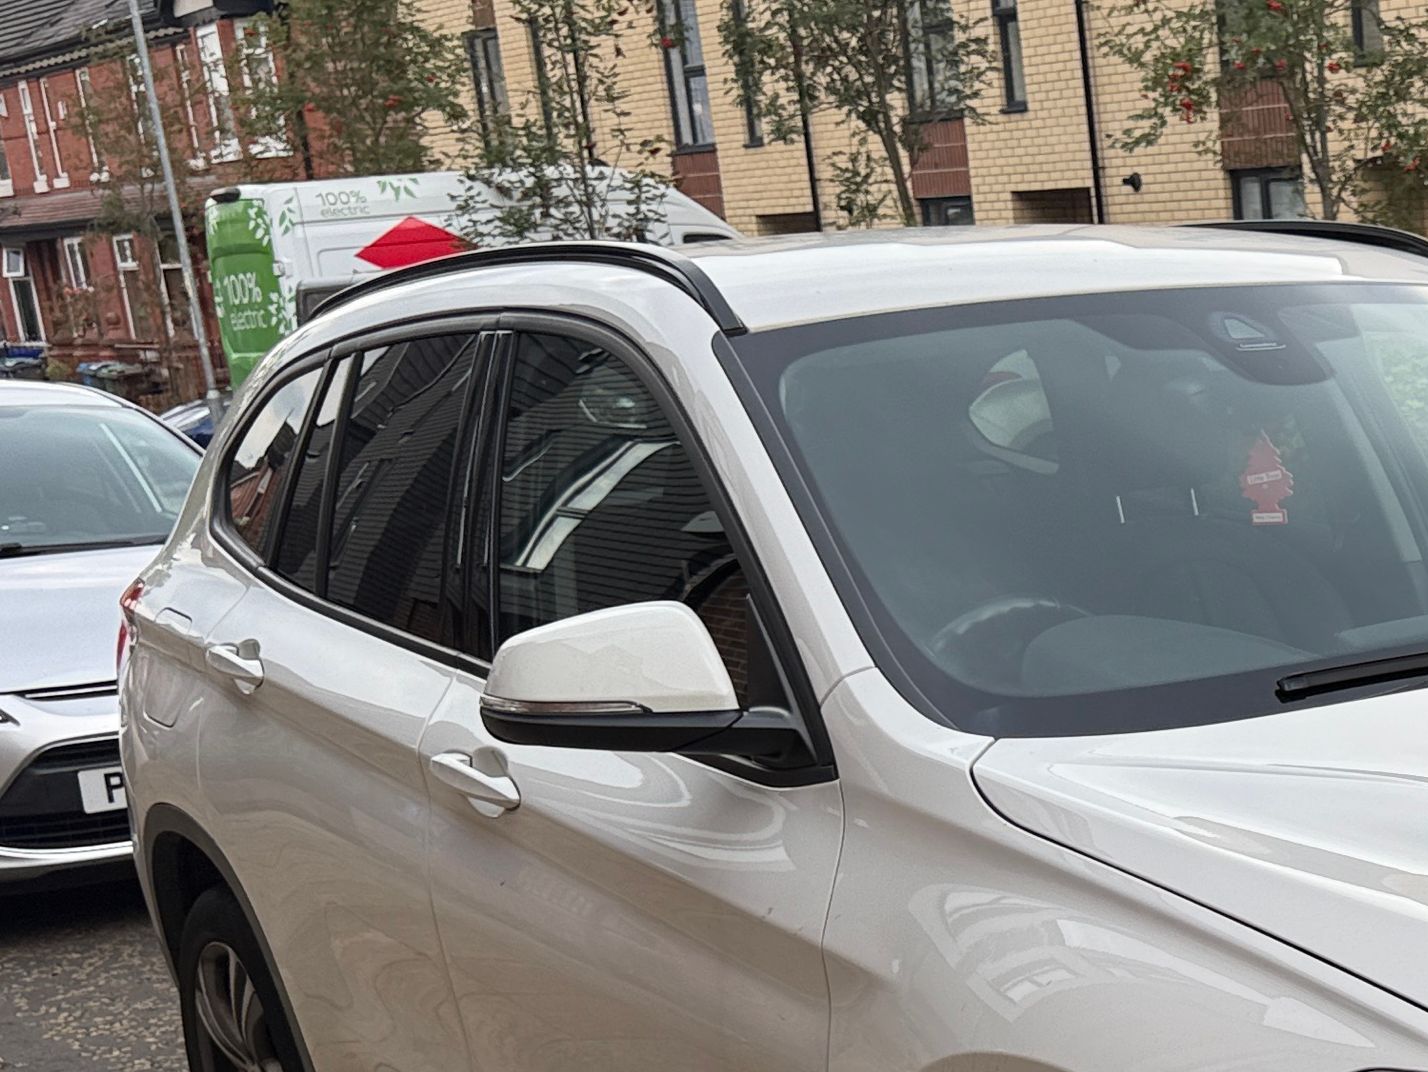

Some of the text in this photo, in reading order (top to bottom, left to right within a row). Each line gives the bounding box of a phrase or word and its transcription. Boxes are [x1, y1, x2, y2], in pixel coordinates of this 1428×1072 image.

[315, 190, 368, 206] 100%
[320, 206, 370, 218] electric
[223, 272, 262, 306] 100%
[230, 309, 268, 331] electric
